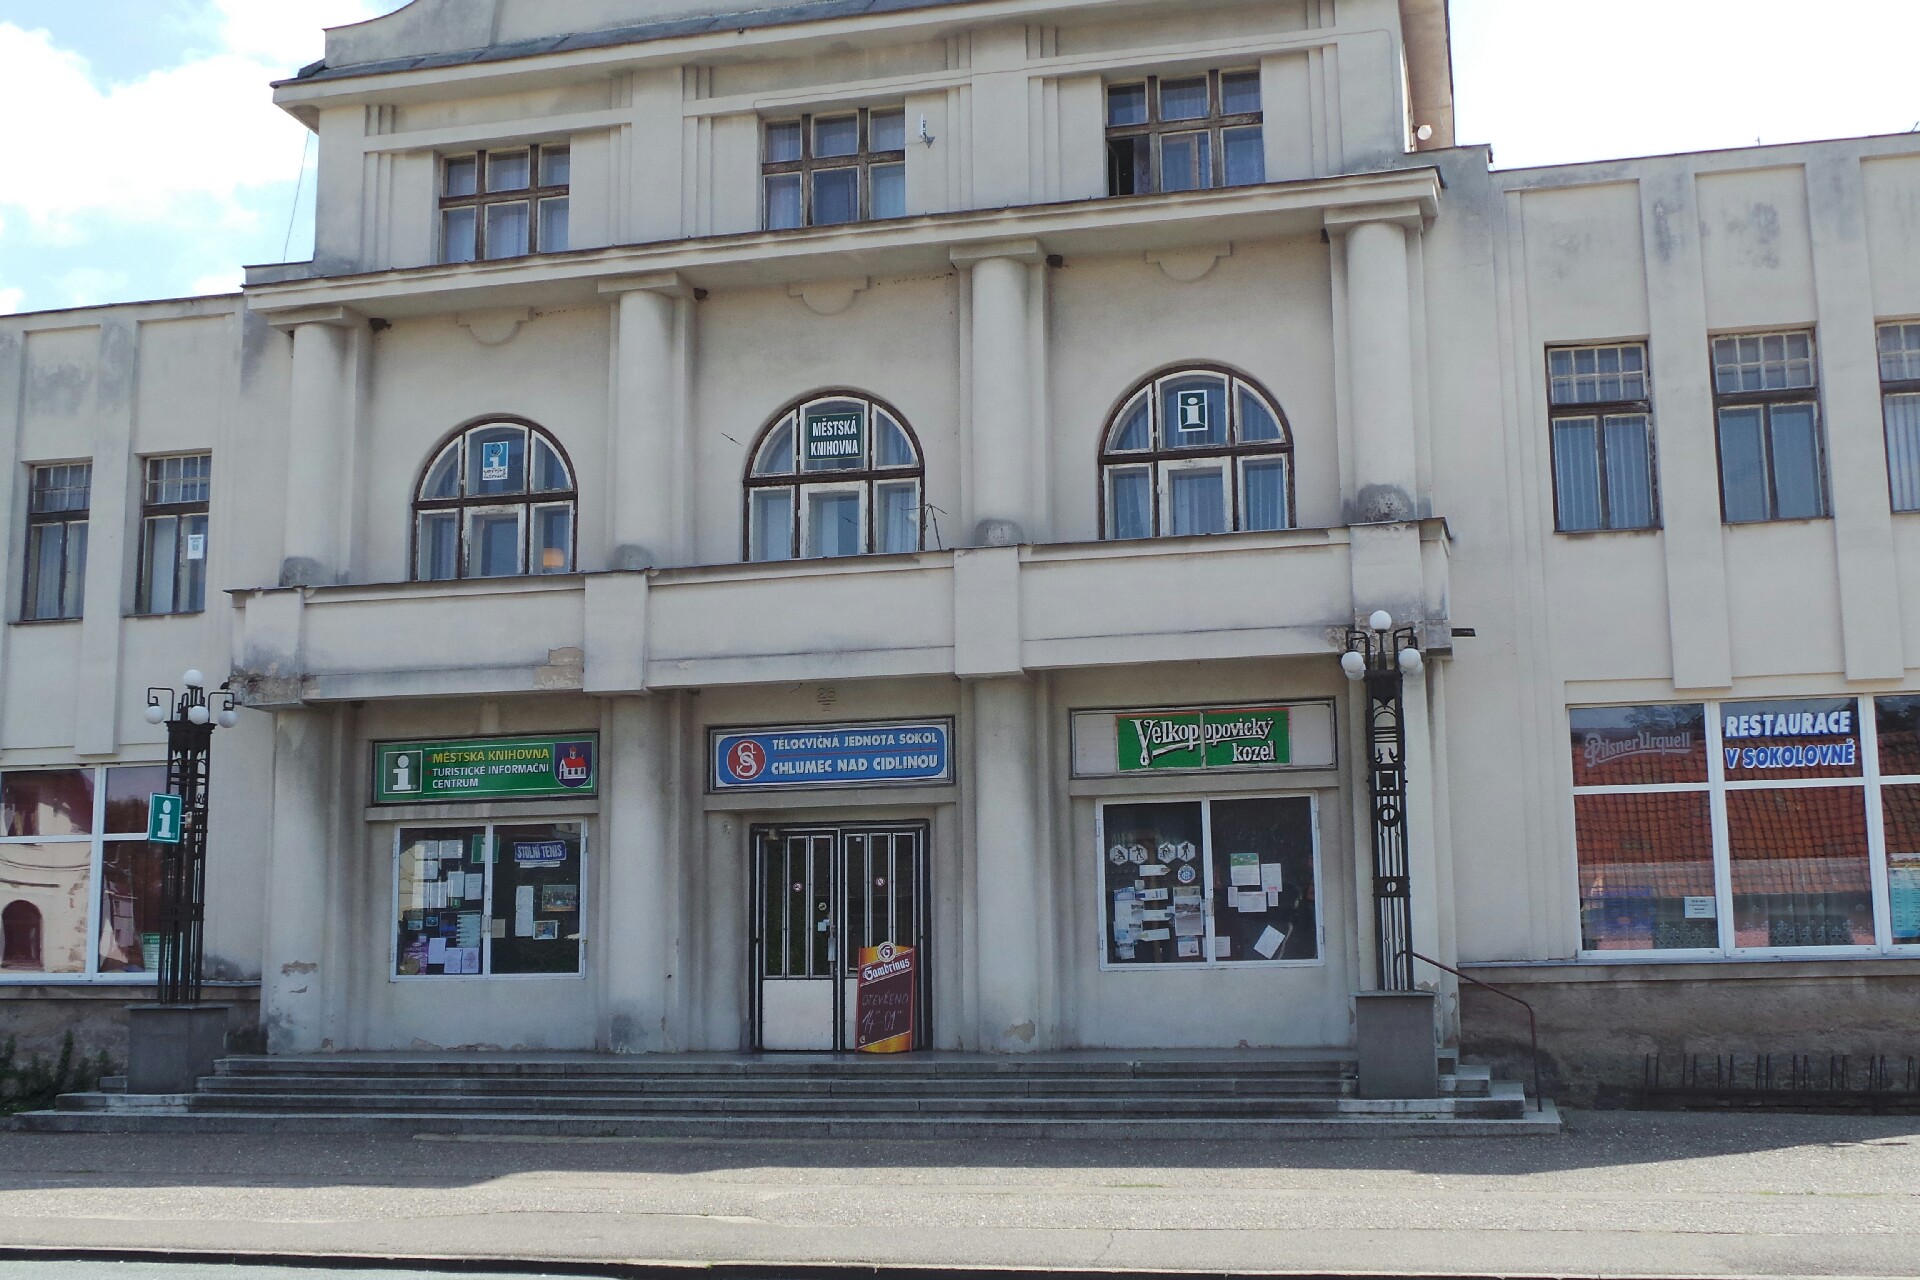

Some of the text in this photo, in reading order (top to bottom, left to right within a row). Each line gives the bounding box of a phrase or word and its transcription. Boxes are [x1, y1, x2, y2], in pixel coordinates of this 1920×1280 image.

[812, 416, 857, 437] MĚSTSKÁ
[810, 440, 859, 456] KNIHOVNA
[1725, 711, 1851, 738] RESTAURACE
[772, 732, 938, 751] TĚLOCVIČNÁ JEDNOTA SOKOL
[1231, 740, 1276, 762] kozel
[1584, 730, 1691, 768] Pilsner Urquell
[432, 748, 550, 764] MĚSTSKÁ KNIHOVNA
[1725, 738, 1856, 769] V SOKOLOVNĚ
[432, 762, 550, 777] TURISTICKÉ INFORMAČNÍ
[771, 754, 938, 775] CHLUMEC NAD CIDLINOU
[432, 778, 479, 789] CENTRUM
[517, 843, 563, 859] STOLNÍ TENIS
[863, 958, 910, 981] Gambrinus
